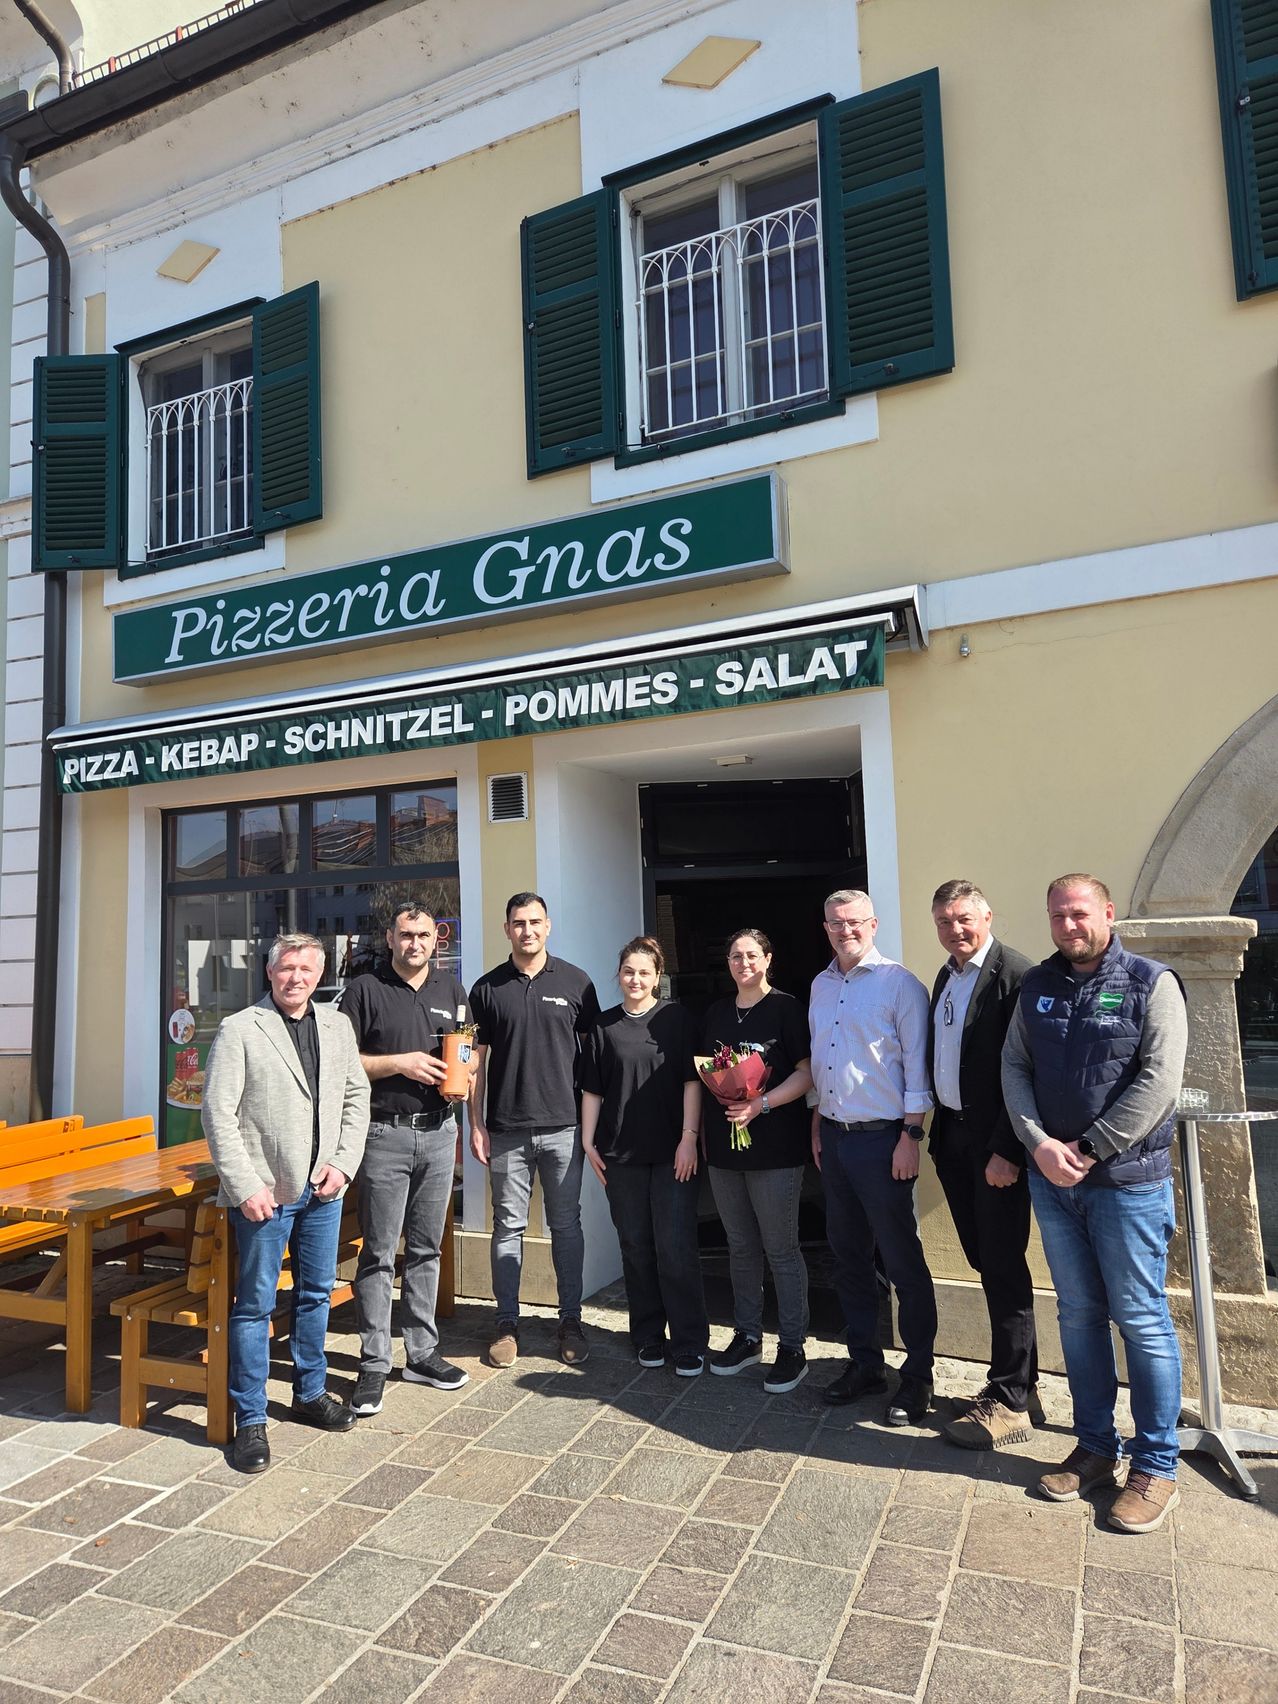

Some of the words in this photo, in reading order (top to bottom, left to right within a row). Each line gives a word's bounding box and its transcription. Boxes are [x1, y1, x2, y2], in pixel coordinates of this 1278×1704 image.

[164, 565, 446, 663] Pizzeria
[472, 518, 693, 604] Gnas
[63, 751, 139, 784] PIZZA
[161, 733, 260, 772] KEBAP
[284, 703, 474, 755] SCHNITZEL
[505, 671, 679, 726] POMMES
[715, 640, 868, 696] SALAT
[436, 922, 450, 969] OPE
